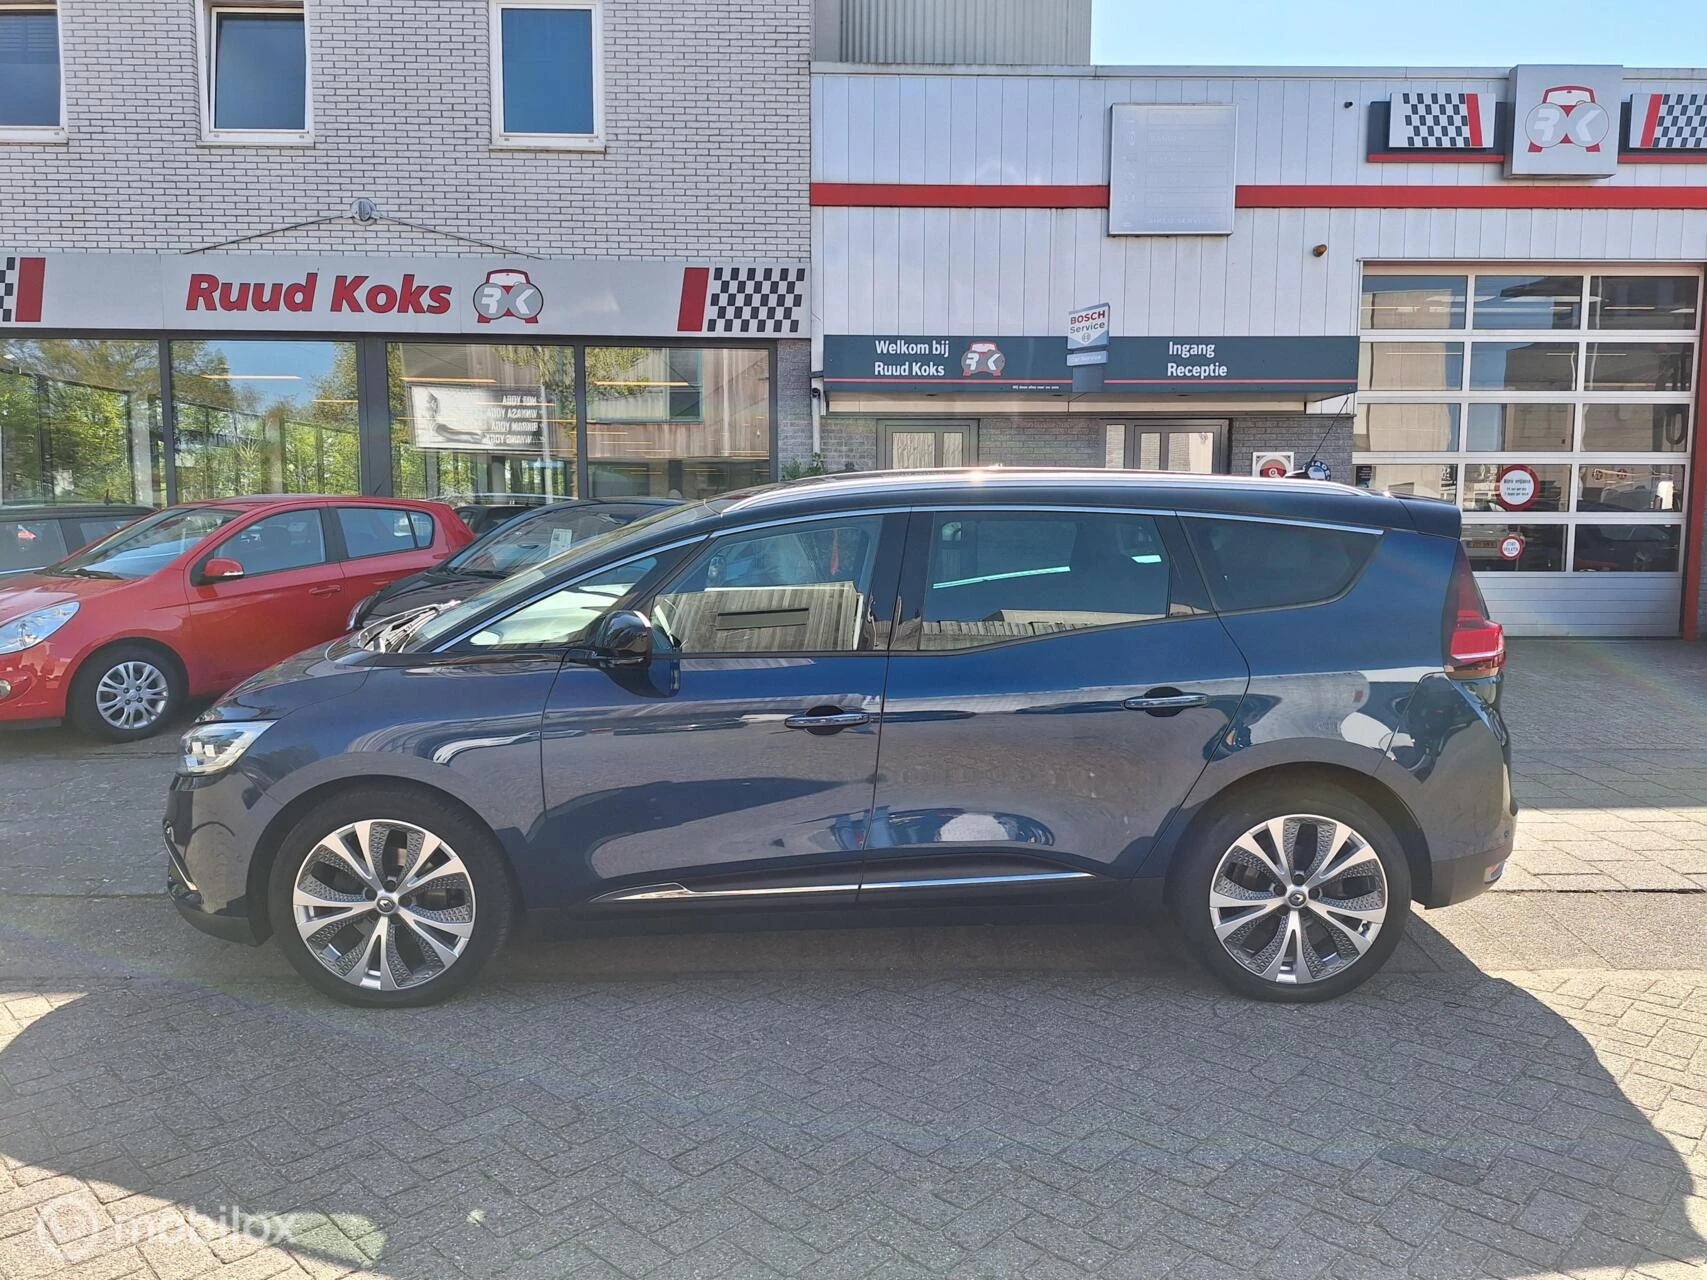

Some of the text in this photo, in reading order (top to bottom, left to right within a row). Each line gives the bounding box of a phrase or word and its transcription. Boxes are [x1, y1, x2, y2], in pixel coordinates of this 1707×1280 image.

[186, 272, 453, 315] Ruud Koks
[1070, 310, 1105, 325] BOSCH
[1069, 321, 1106, 334] Service
[875, 340, 949, 357] Welkom bij
[1168, 341, 1215, 358] Ingang
[874, 362, 945, 376] Ruud Koks
[1167, 362, 1228, 379] Receptie
